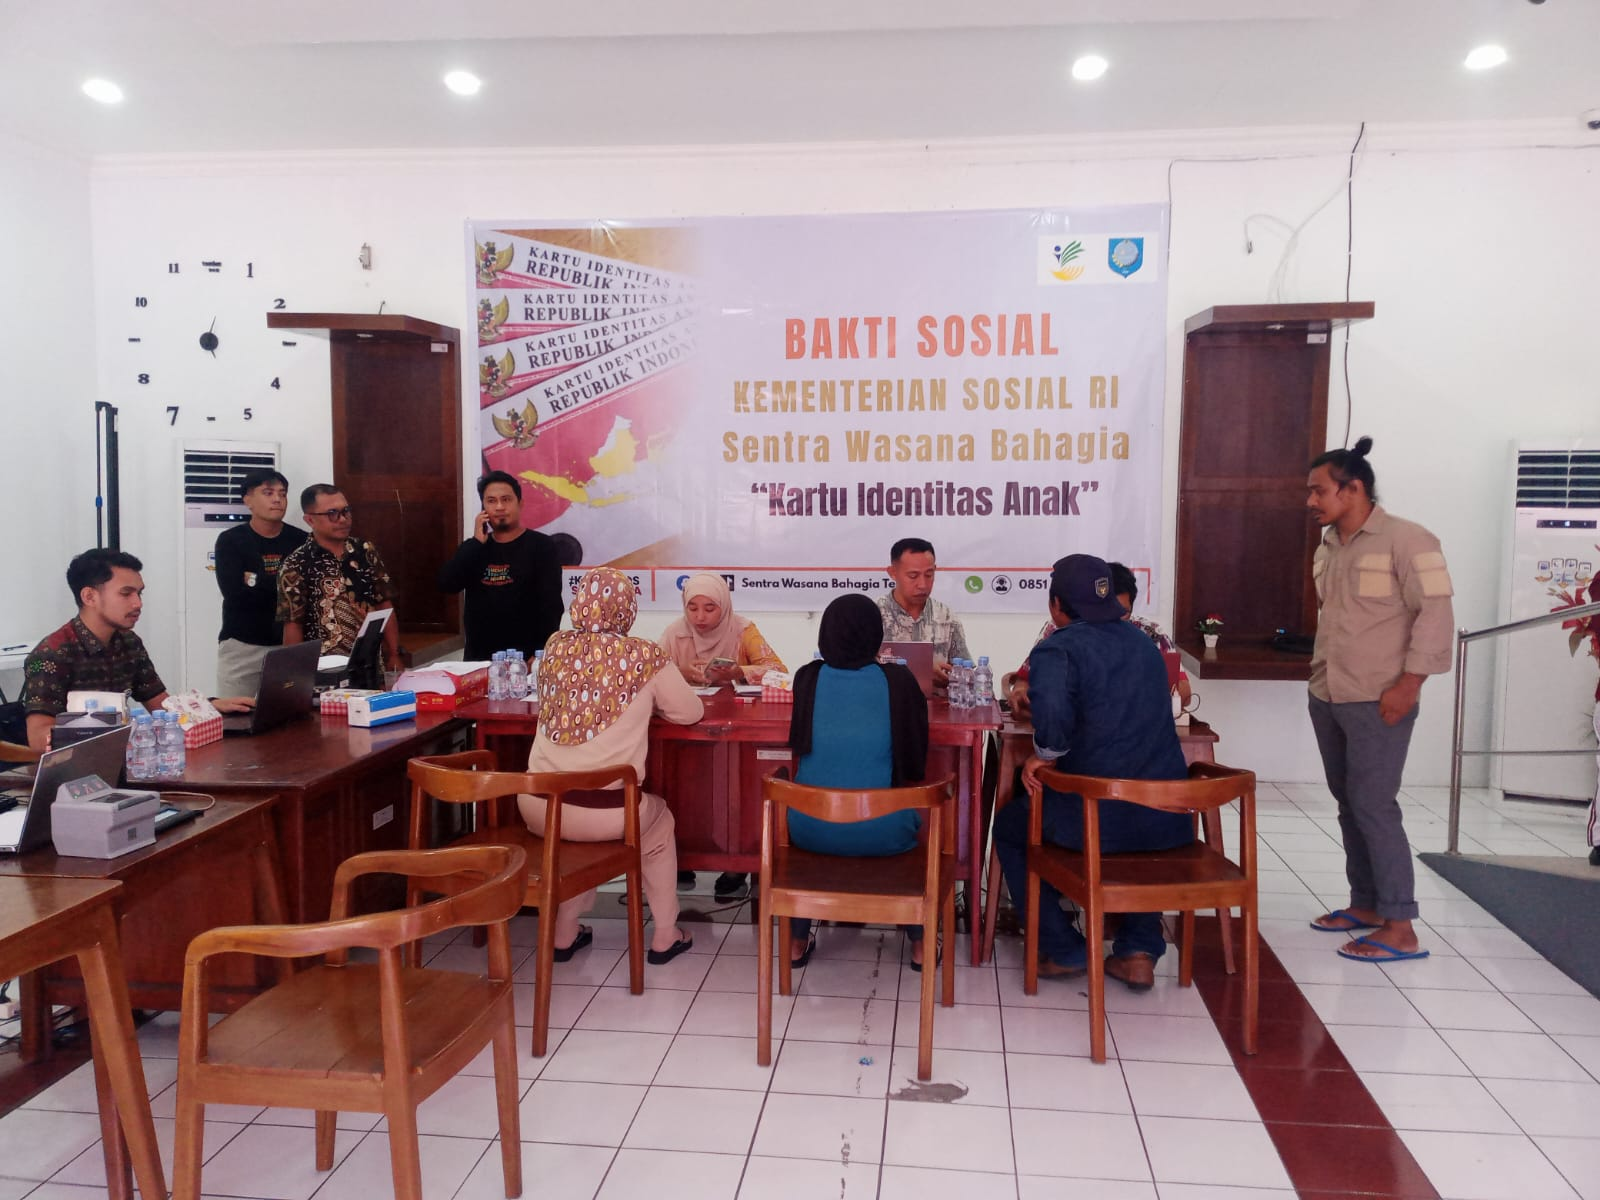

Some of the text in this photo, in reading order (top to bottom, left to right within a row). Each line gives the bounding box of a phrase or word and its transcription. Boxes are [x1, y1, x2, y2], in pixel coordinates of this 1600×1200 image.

[168, 262, 180, 274] 11
[246, 262, 254, 278] 1
[525, 259, 614, 289] REPUBLIK
[529, 246, 670, 289] KARTU IDENTITAS
[135, 296, 148, 308] 10
[273, 298, 286, 310] 2
[524, 294, 576, 305] KARTU
[583, 294, 668, 305] IDENTITAS
[524, 307, 612, 321] REPUBLIK
[525, 332, 577, 353] KARTU
[584, 313, 667, 340] IDENTITAS
[785, 313, 1059, 360] BAKTI SOSIAL
[528, 338, 616, 369] REPUBLIK
[138, 373, 150, 385] 8
[270, 377, 281, 390] 4
[544, 369, 593, 399] KARTU
[549, 367, 634, 414] REPUBLIK
[734, 375, 1119, 413] KEMENTERIAN SOSIAL RI
[166, 406, 180, 426] 7
[243, 408, 253, 421] 5
[722, 426, 1130, 465] Sentra Wasana Bahagia
[751, 480, 1099, 517] “Kartu Identitas Anak”
[742, 578, 896, 591] Sentra Wasana Bahagia Te
